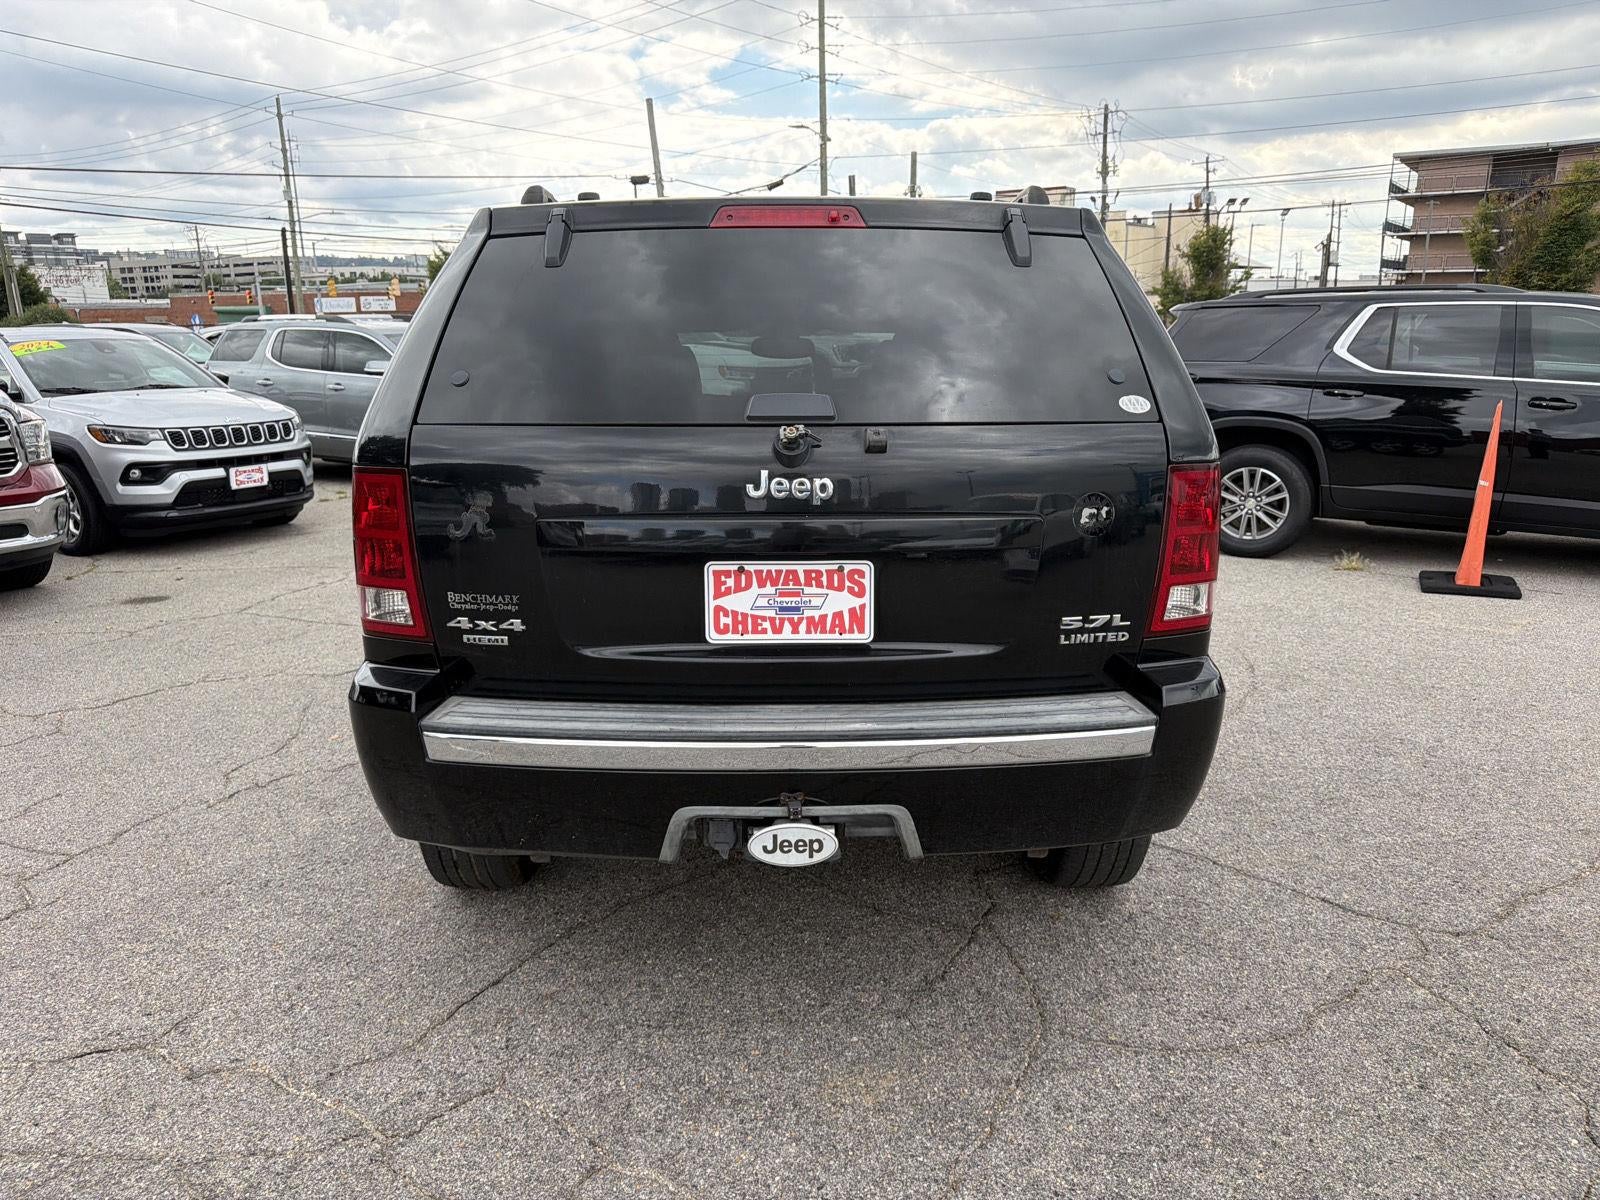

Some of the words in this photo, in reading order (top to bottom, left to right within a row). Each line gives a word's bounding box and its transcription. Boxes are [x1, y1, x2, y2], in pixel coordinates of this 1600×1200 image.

[745, 469, 834, 506] Jeep
[712, 568, 867, 601] EDWARDS
[766, 598, 812, 606] Chevrolet
[713, 603, 867, 636] CHEVYMAN
[1060, 614, 1131, 629] 5.7L
[463, 634, 508, 646] HEMI
[1060, 631, 1129, 645] LIMITED
[761, 833, 825, 859] Jeep
